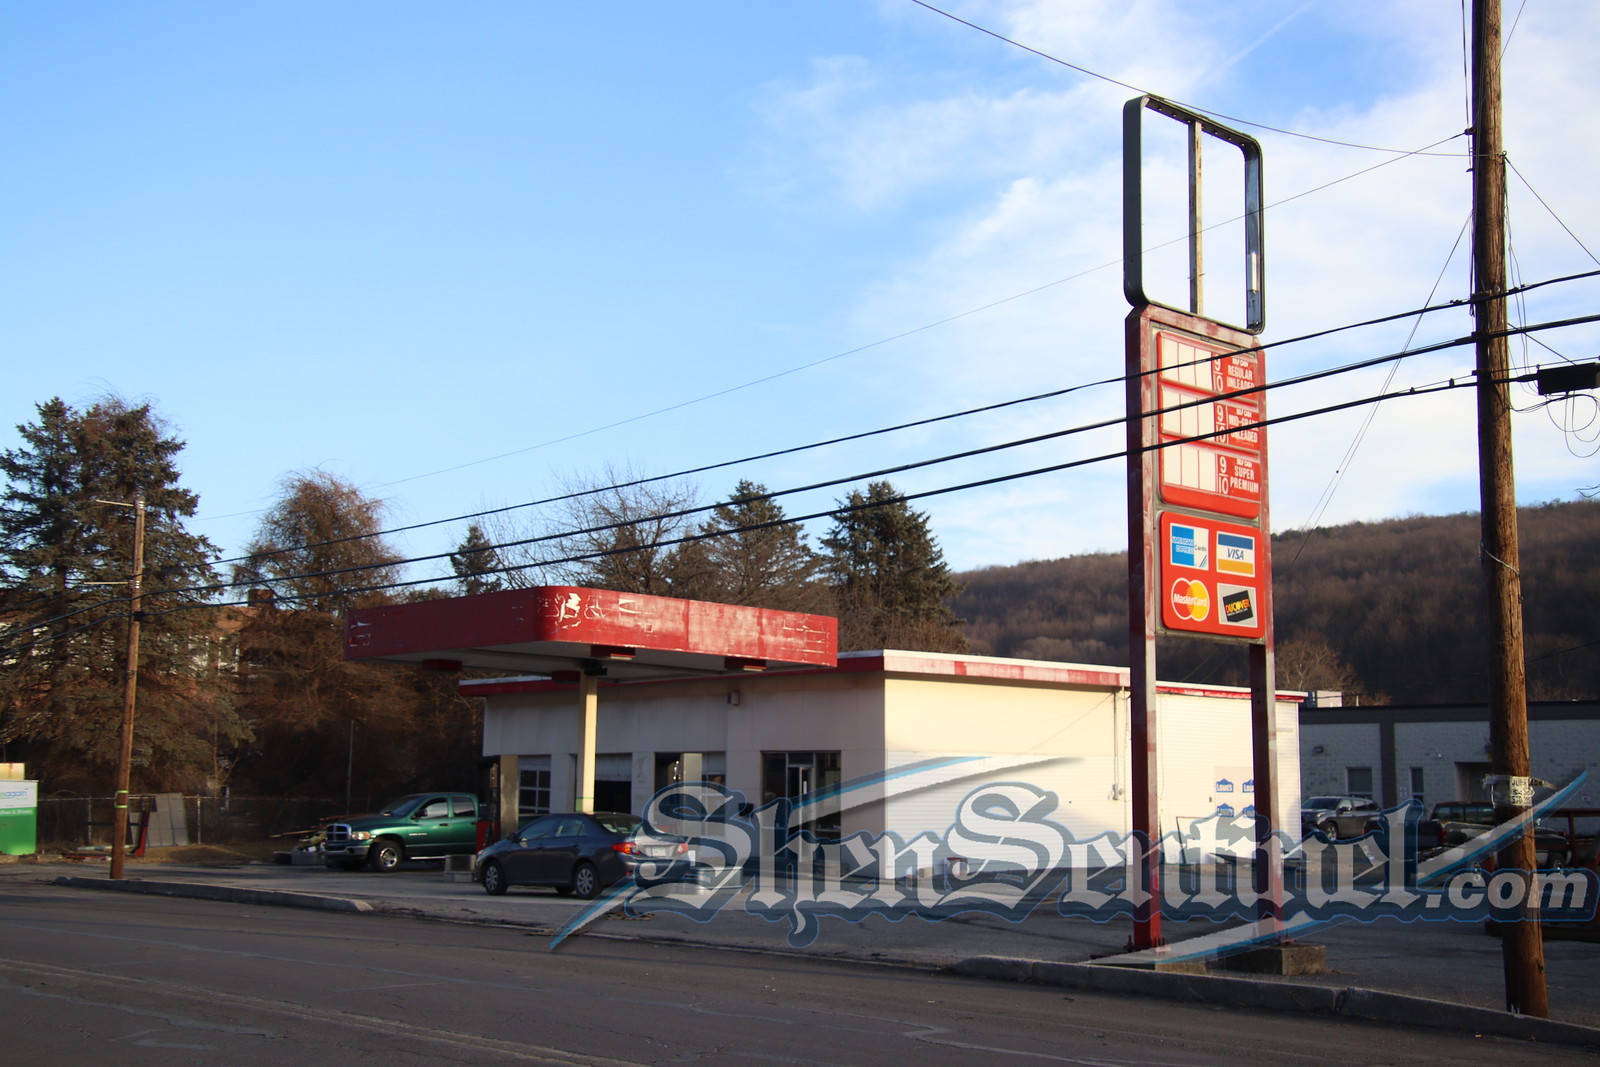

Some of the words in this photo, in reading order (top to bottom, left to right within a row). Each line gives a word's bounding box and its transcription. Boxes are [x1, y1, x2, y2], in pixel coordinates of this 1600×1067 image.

[1227, 365, 1253, 380] REGULAR
[1213, 374, 1224, 392] 10
[1226, 376, 1255, 390] UNLEADED
[1216, 404, 1224, 422] 9
[1230, 426, 1258, 443] UNLEADED
[1219, 456, 1227, 474] 9
[1234, 466, 1255, 480] SUPER
[1218, 477, 1229, 494] 10
[1230, 478, 1259, 494] PREMIUM
[1172, 536, 1194, 546] AMERICAN
[1227, 547, 1245, 561] VISA
[1173, 593, 1208, 607] MasterCard
